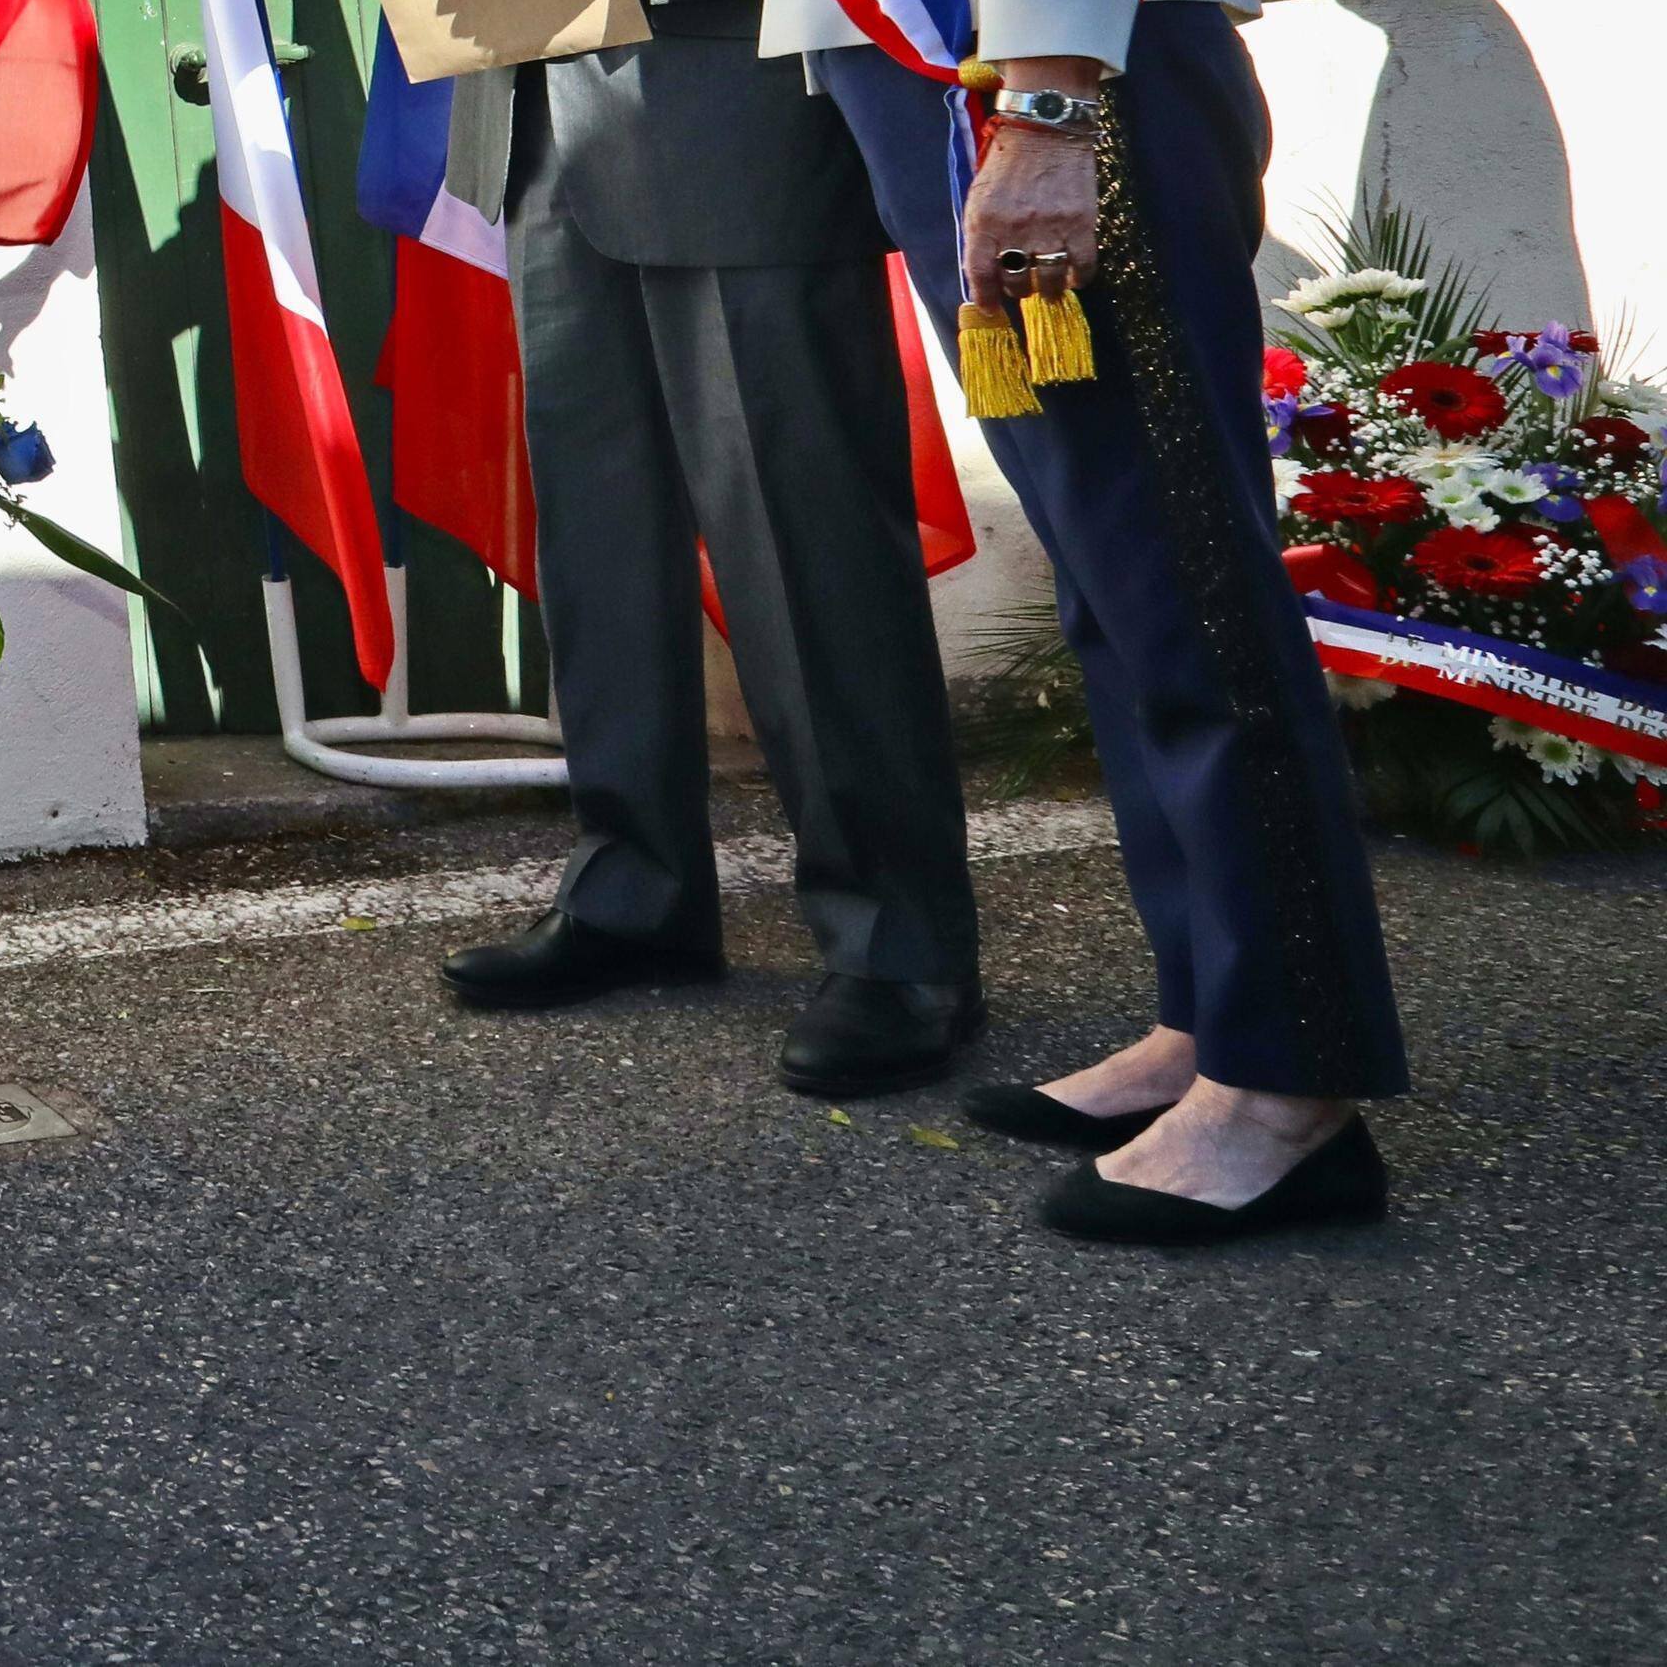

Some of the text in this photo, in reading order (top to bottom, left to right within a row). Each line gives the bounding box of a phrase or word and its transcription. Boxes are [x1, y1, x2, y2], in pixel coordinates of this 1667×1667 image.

[1437, 664, 1599, 718] MINISTRE
[1441, 640, 1600, 702] MINISTRE
[1617, 697, 1667, 724] DE
